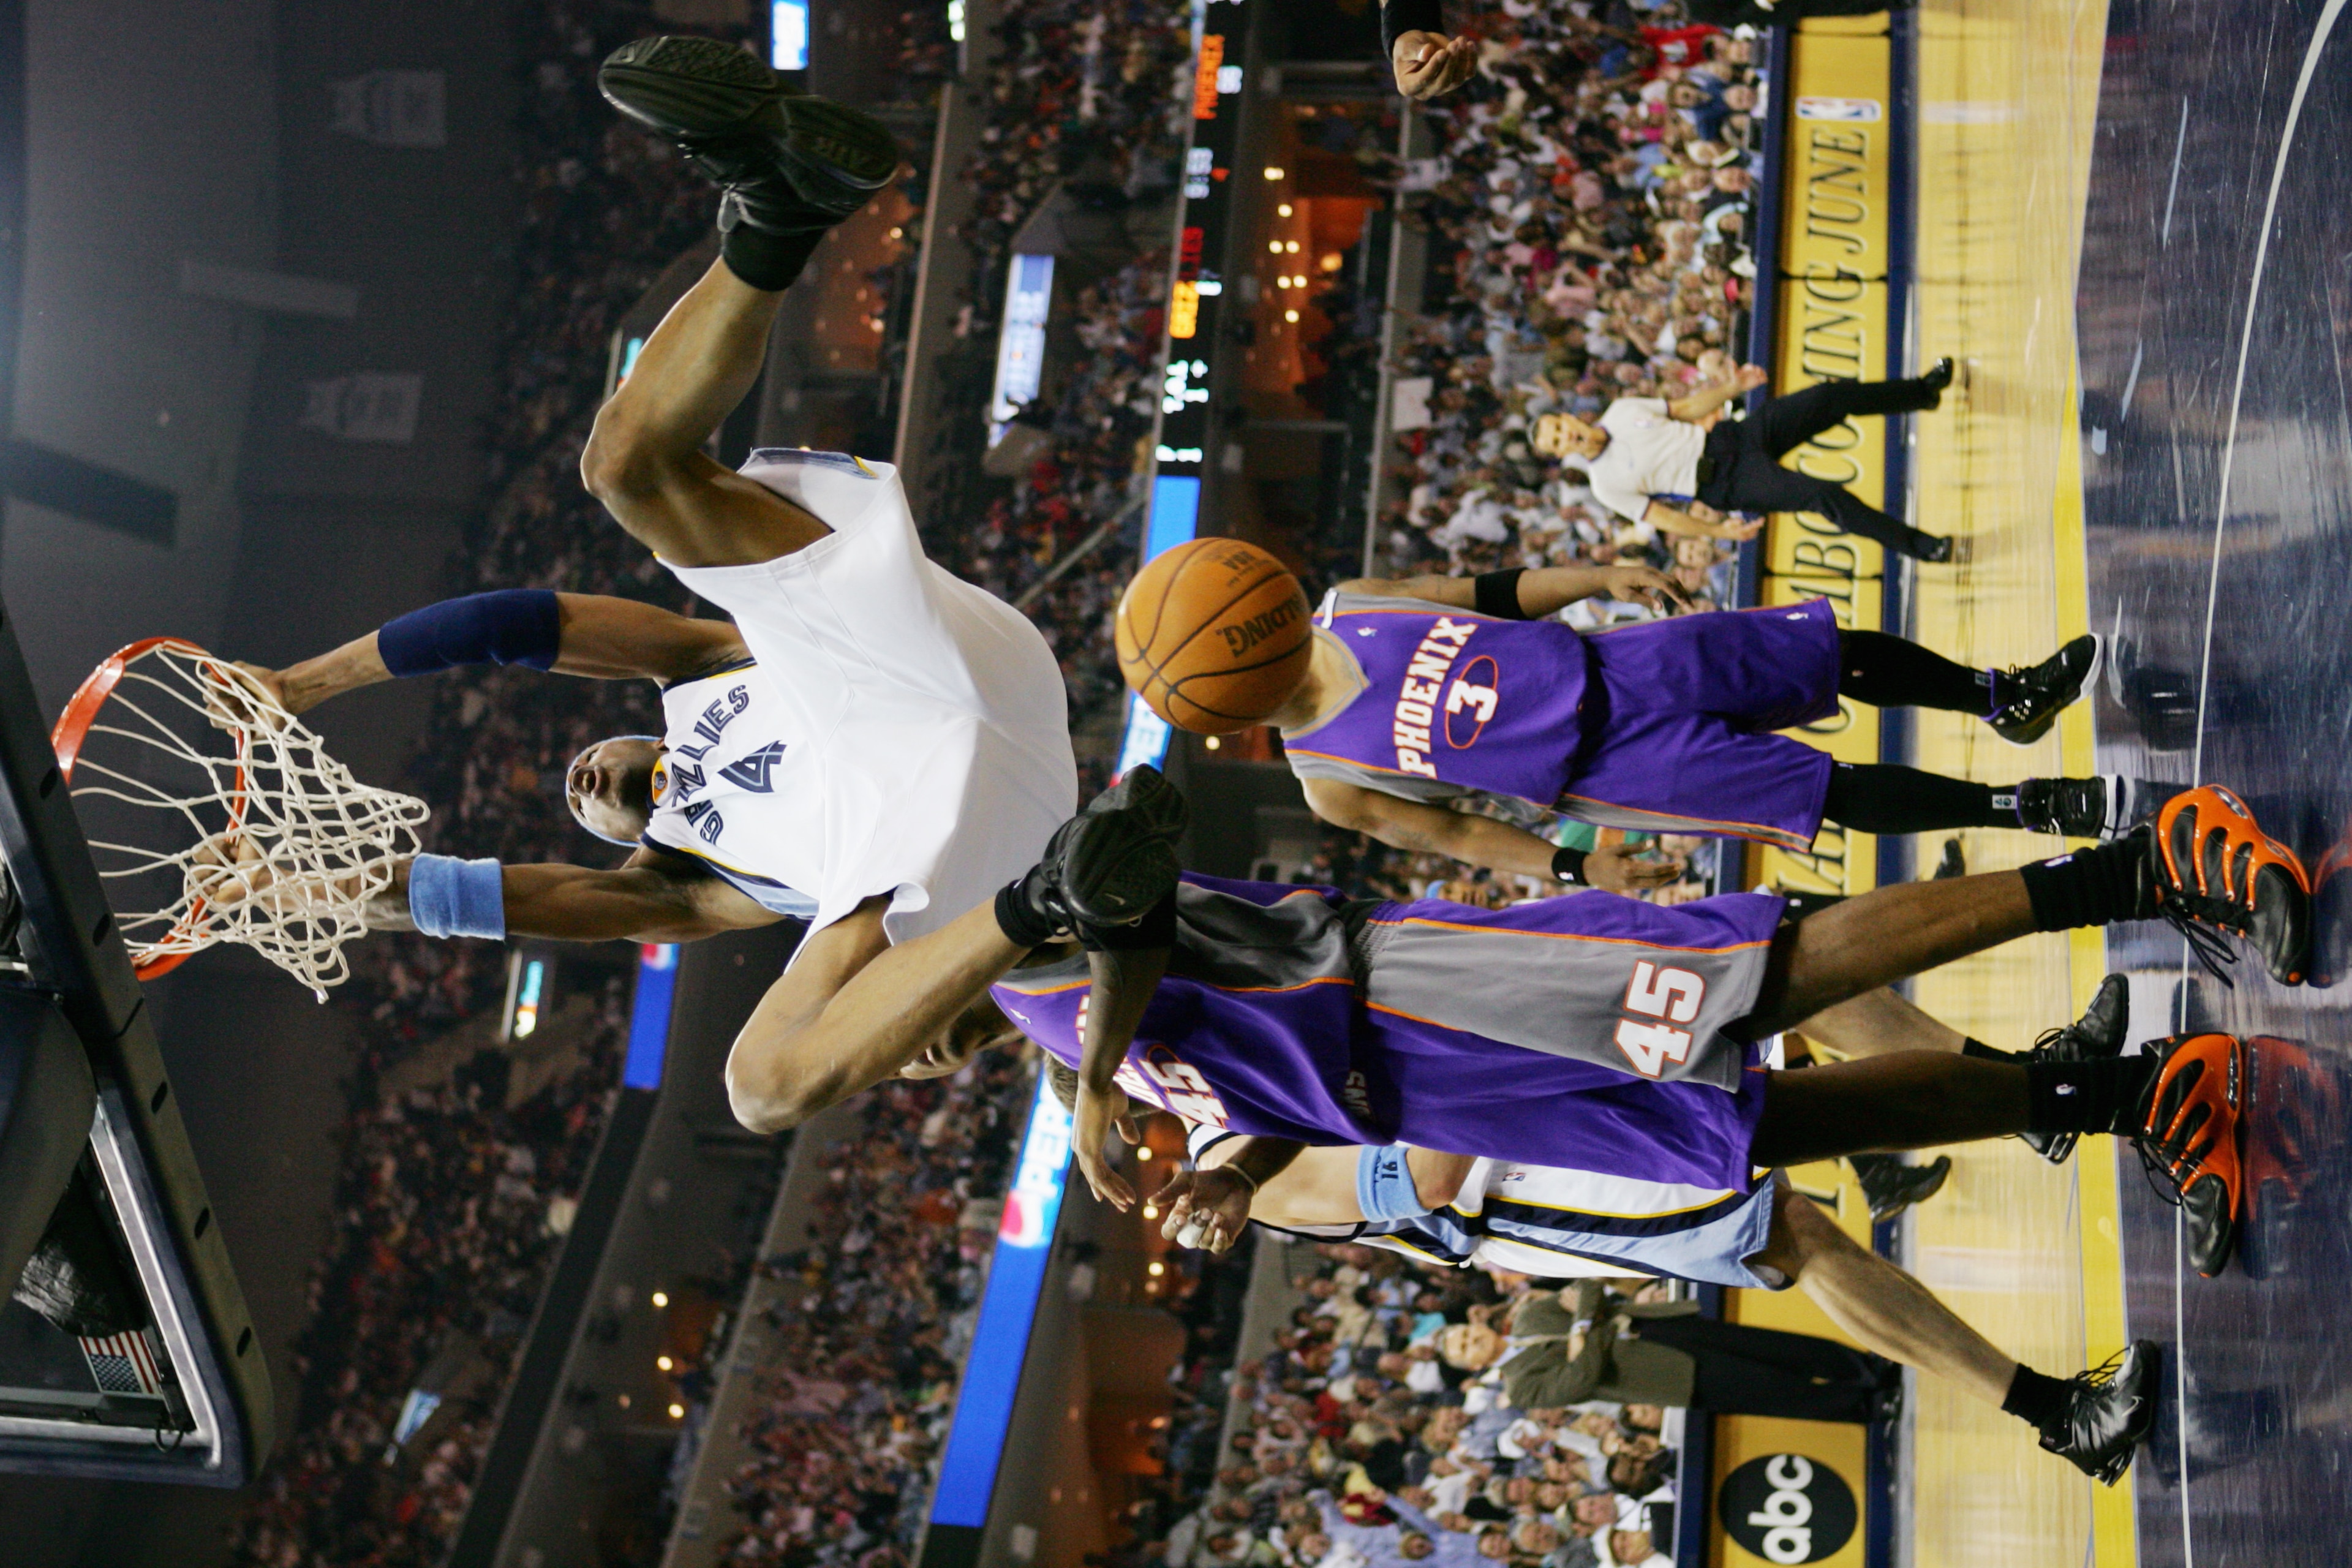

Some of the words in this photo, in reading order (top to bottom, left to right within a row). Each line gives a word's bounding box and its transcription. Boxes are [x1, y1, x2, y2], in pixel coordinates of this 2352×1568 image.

[1806, 130, 1865, 255] JUNE
[1120, 694, 1169, 772] PEP
[1392, 616, 1479, 780] PHOENIX
[1443, 679, 1499, 723] 3
[717, 740, 788, 793] 4
[1612, 958, 1706, 1079] 45
[1137, 1058, 1231, 1129] 45
[1381, 1161, 1399, 1180] 16
[1747, 1453, 1814, 1564] abc
